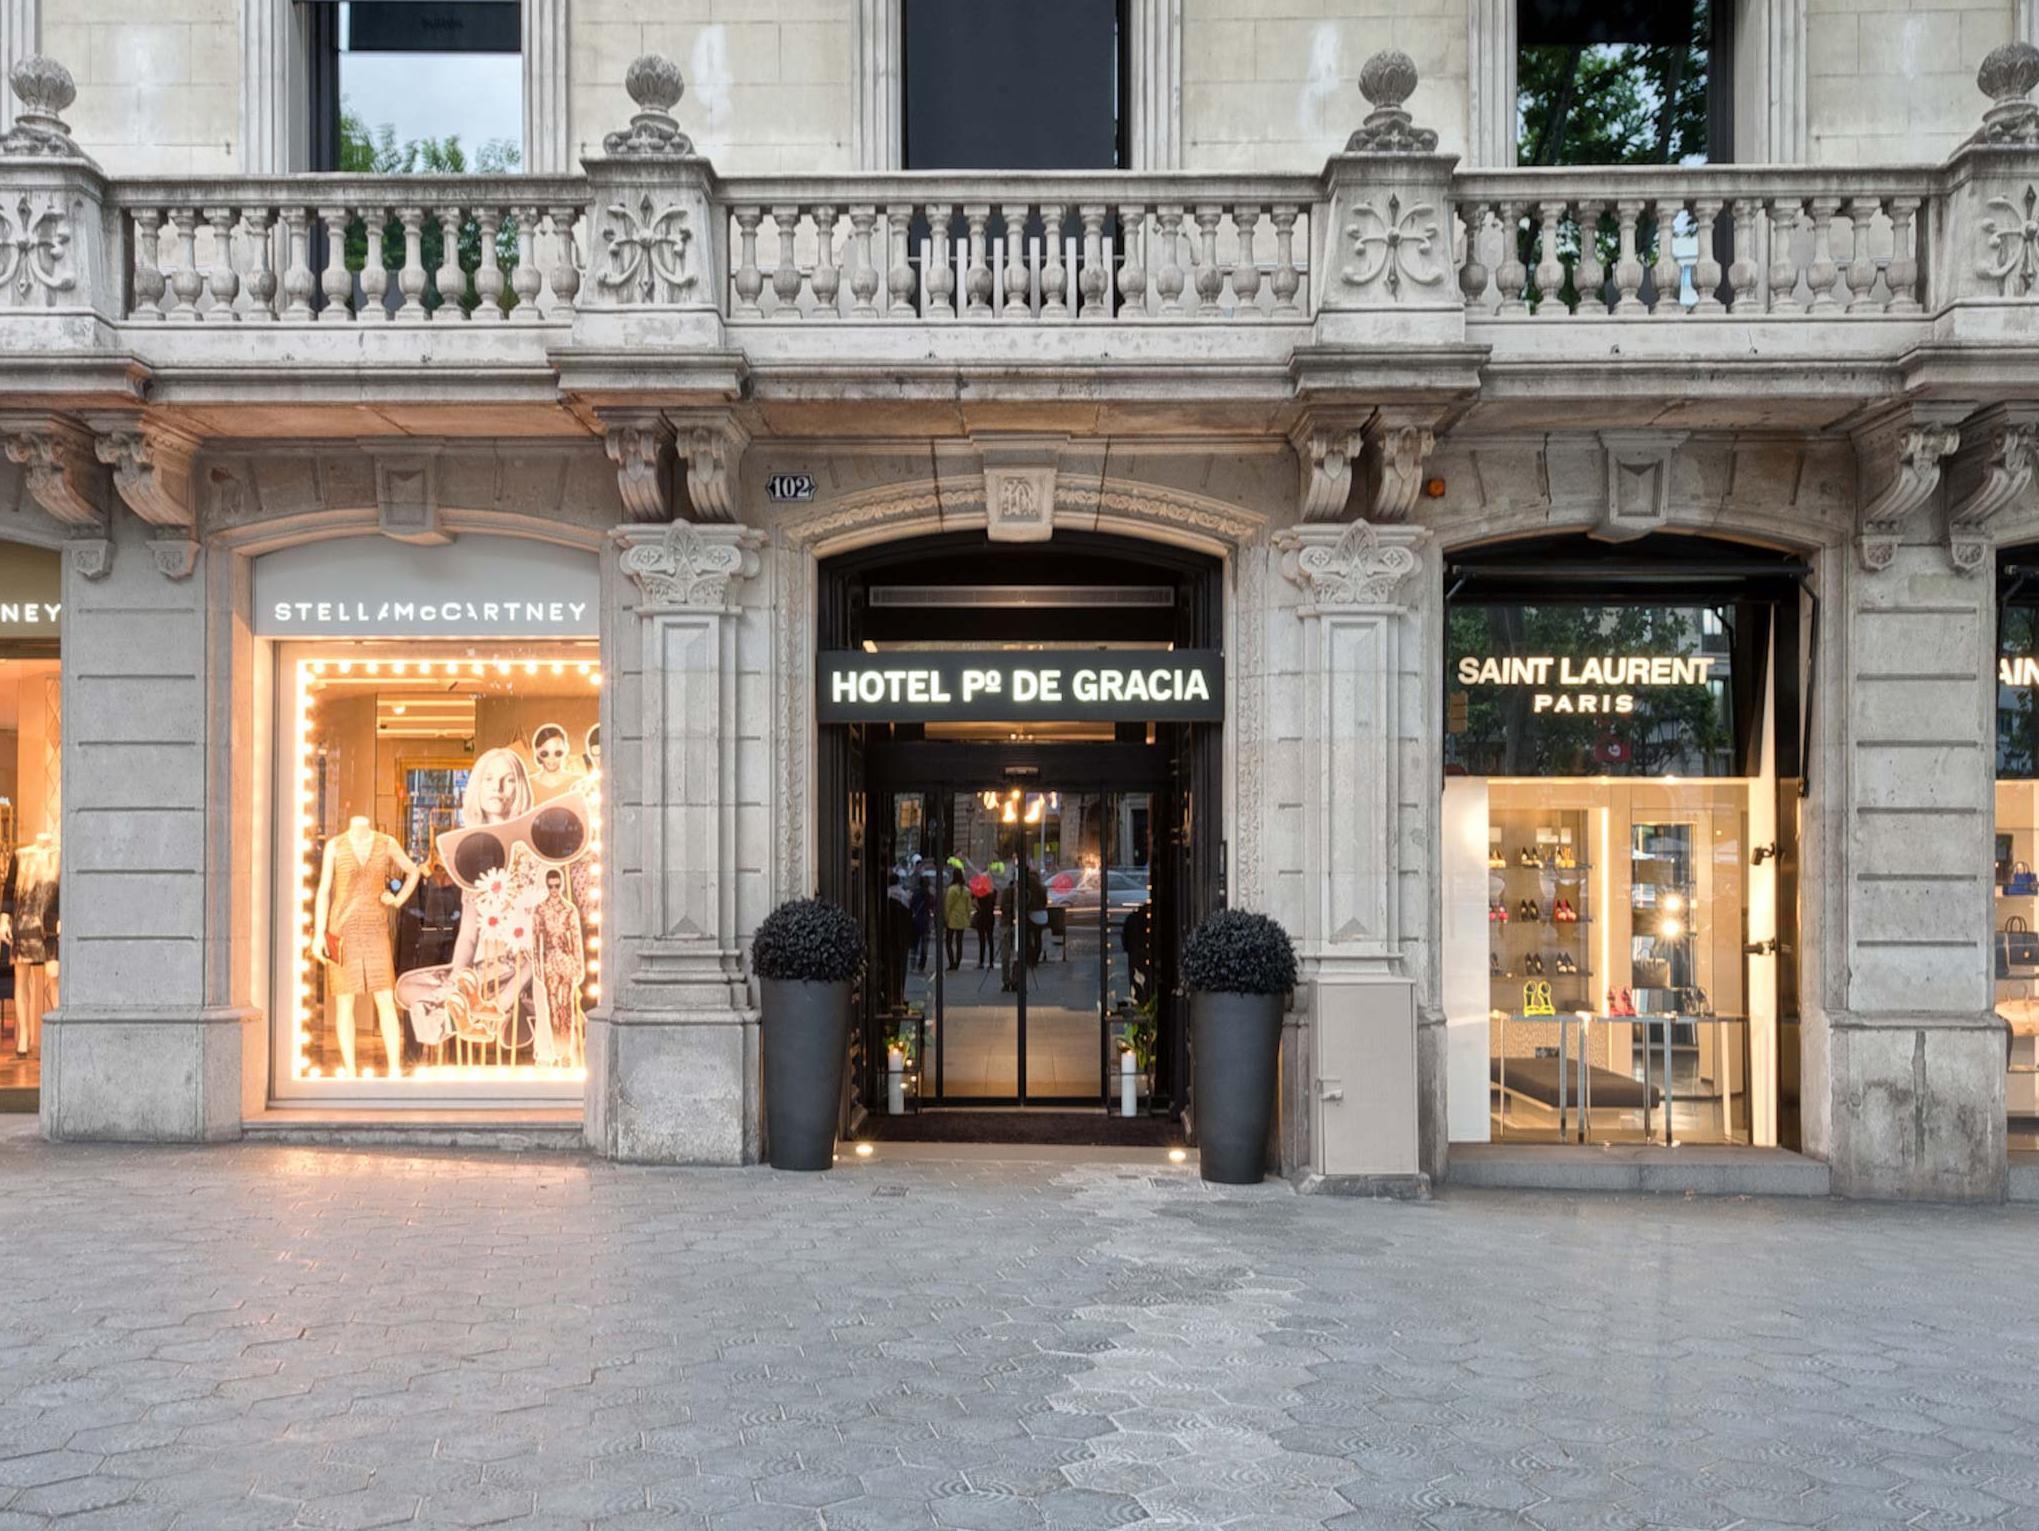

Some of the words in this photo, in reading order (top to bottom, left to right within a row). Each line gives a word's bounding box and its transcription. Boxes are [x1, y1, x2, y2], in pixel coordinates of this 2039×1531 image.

[774, 476, 810, 498] 102
[1457, 657, 1553, 685] SAINT
[1560, 657, 1715, 685] LAURENT
[832, 671, 951, 702] HOTEL
[1013, 670, 1062, 701] DE
[1072, 669, 1210, 700] GRACIA
[1533, 694, 1634, 713] PARIS
